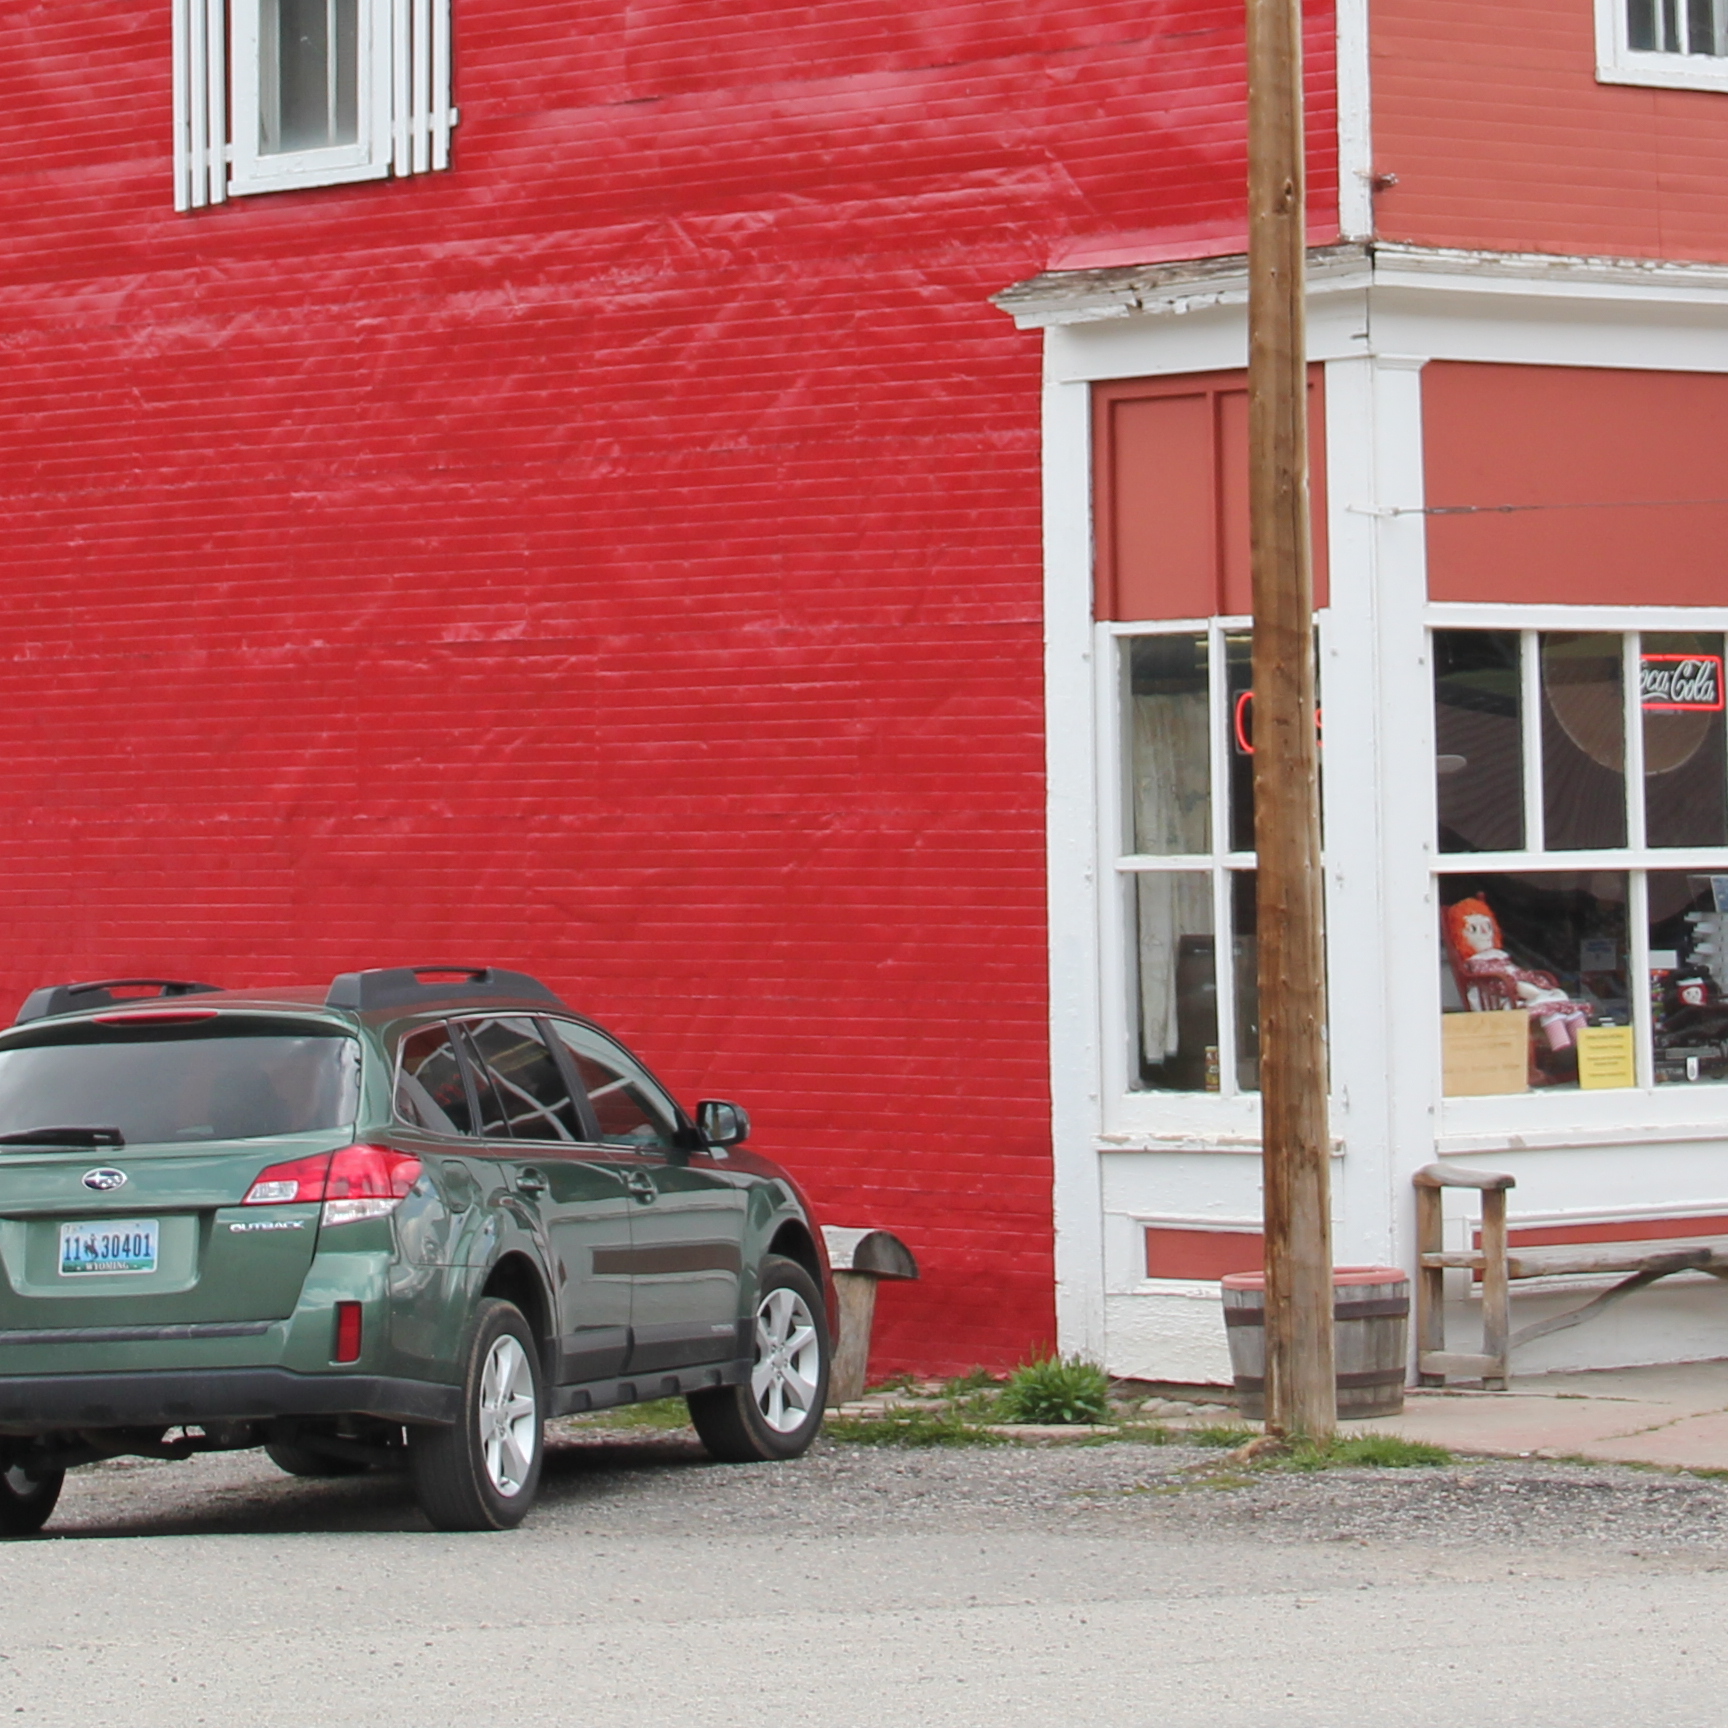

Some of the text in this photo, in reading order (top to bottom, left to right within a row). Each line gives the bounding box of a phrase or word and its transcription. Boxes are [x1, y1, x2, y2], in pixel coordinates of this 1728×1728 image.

[1639, 659, 1716, 702] oca-Cola
[64, 1232, 151, 1261] 11 30401
[85, 1261, 130, 1271] WYOMING
